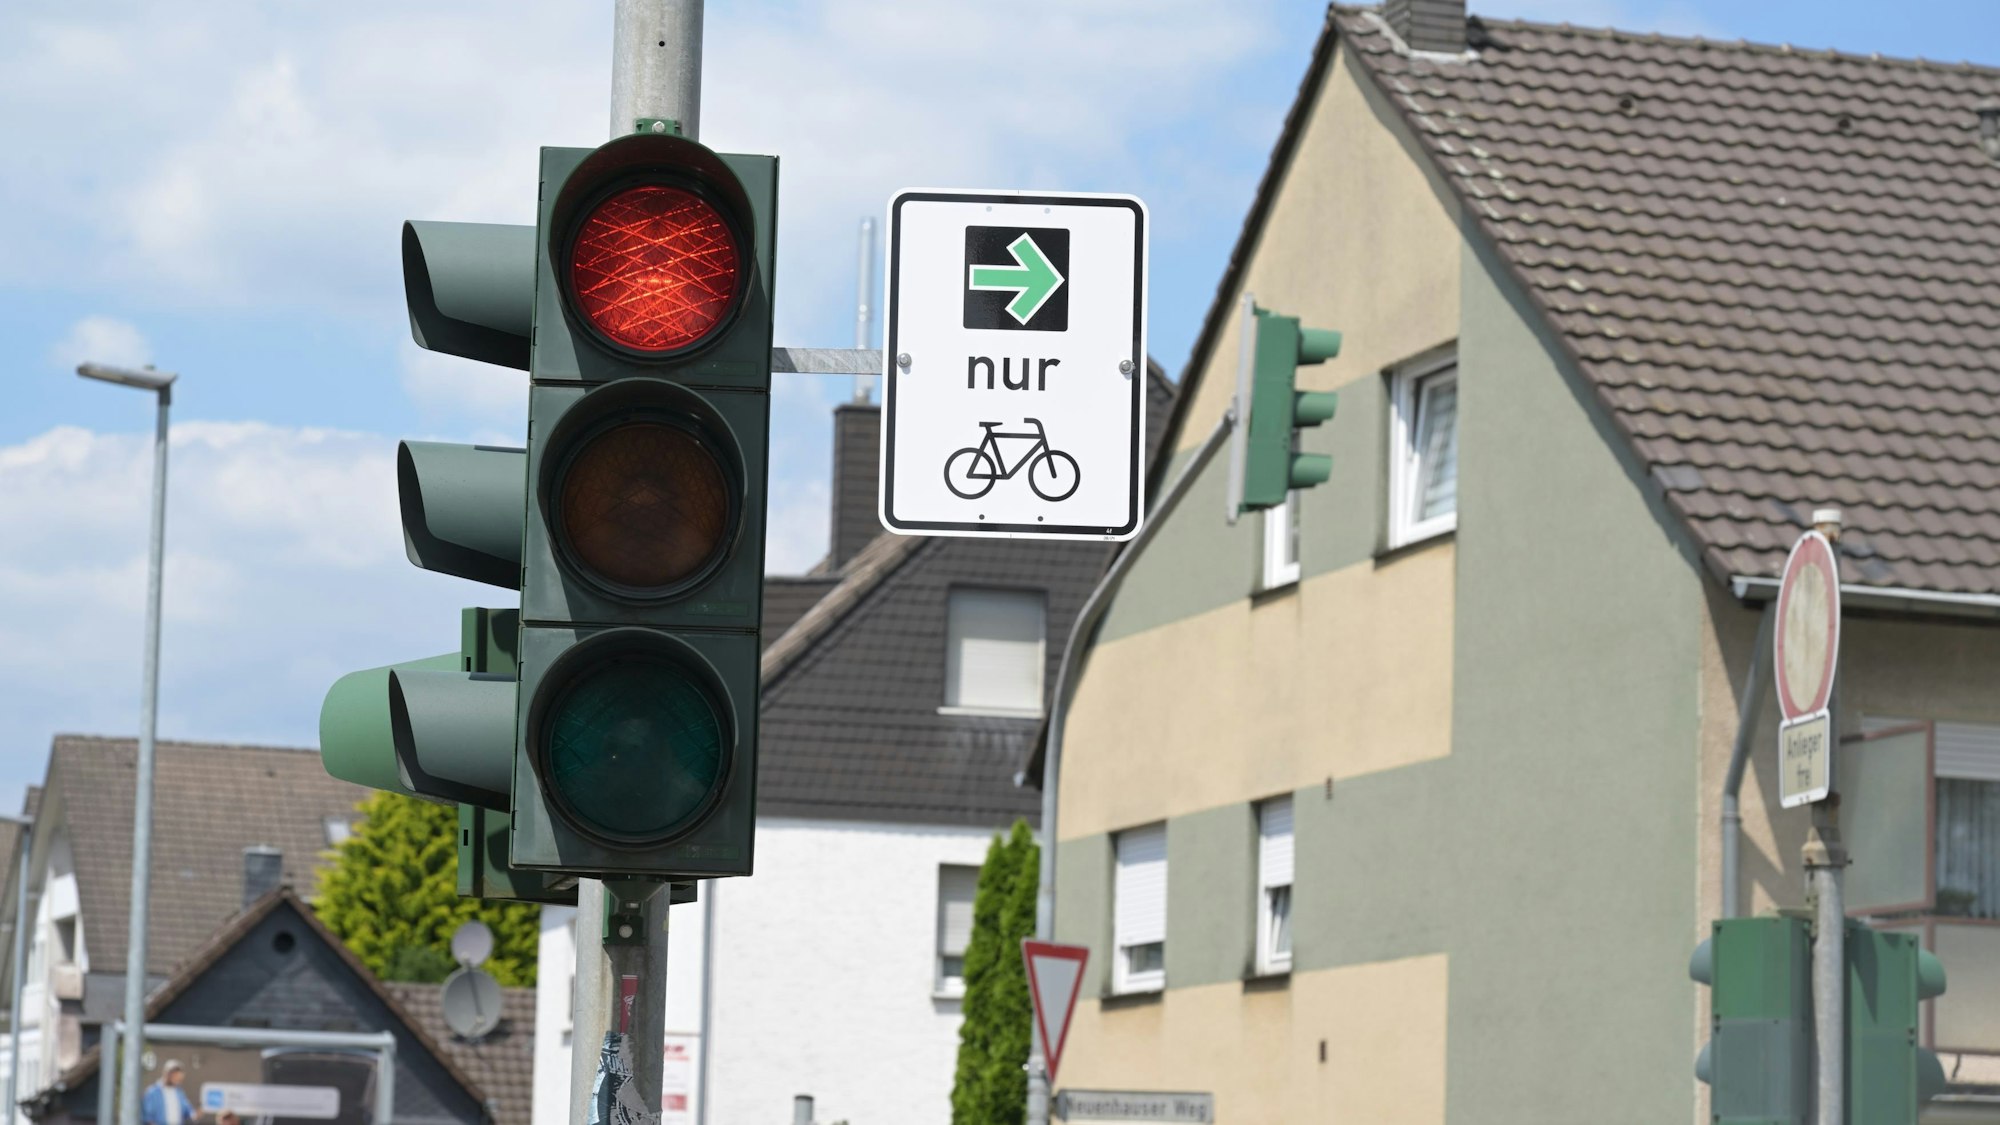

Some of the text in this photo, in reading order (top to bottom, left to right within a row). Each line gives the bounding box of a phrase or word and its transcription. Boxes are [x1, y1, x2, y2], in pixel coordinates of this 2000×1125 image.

[967, 356, 1061, 391] nur
[1786, 732, 1822, 764] Anlieger
[1797, 764, 1812, 789] frei
[1173, 1099, 1207, 1120] Weg
